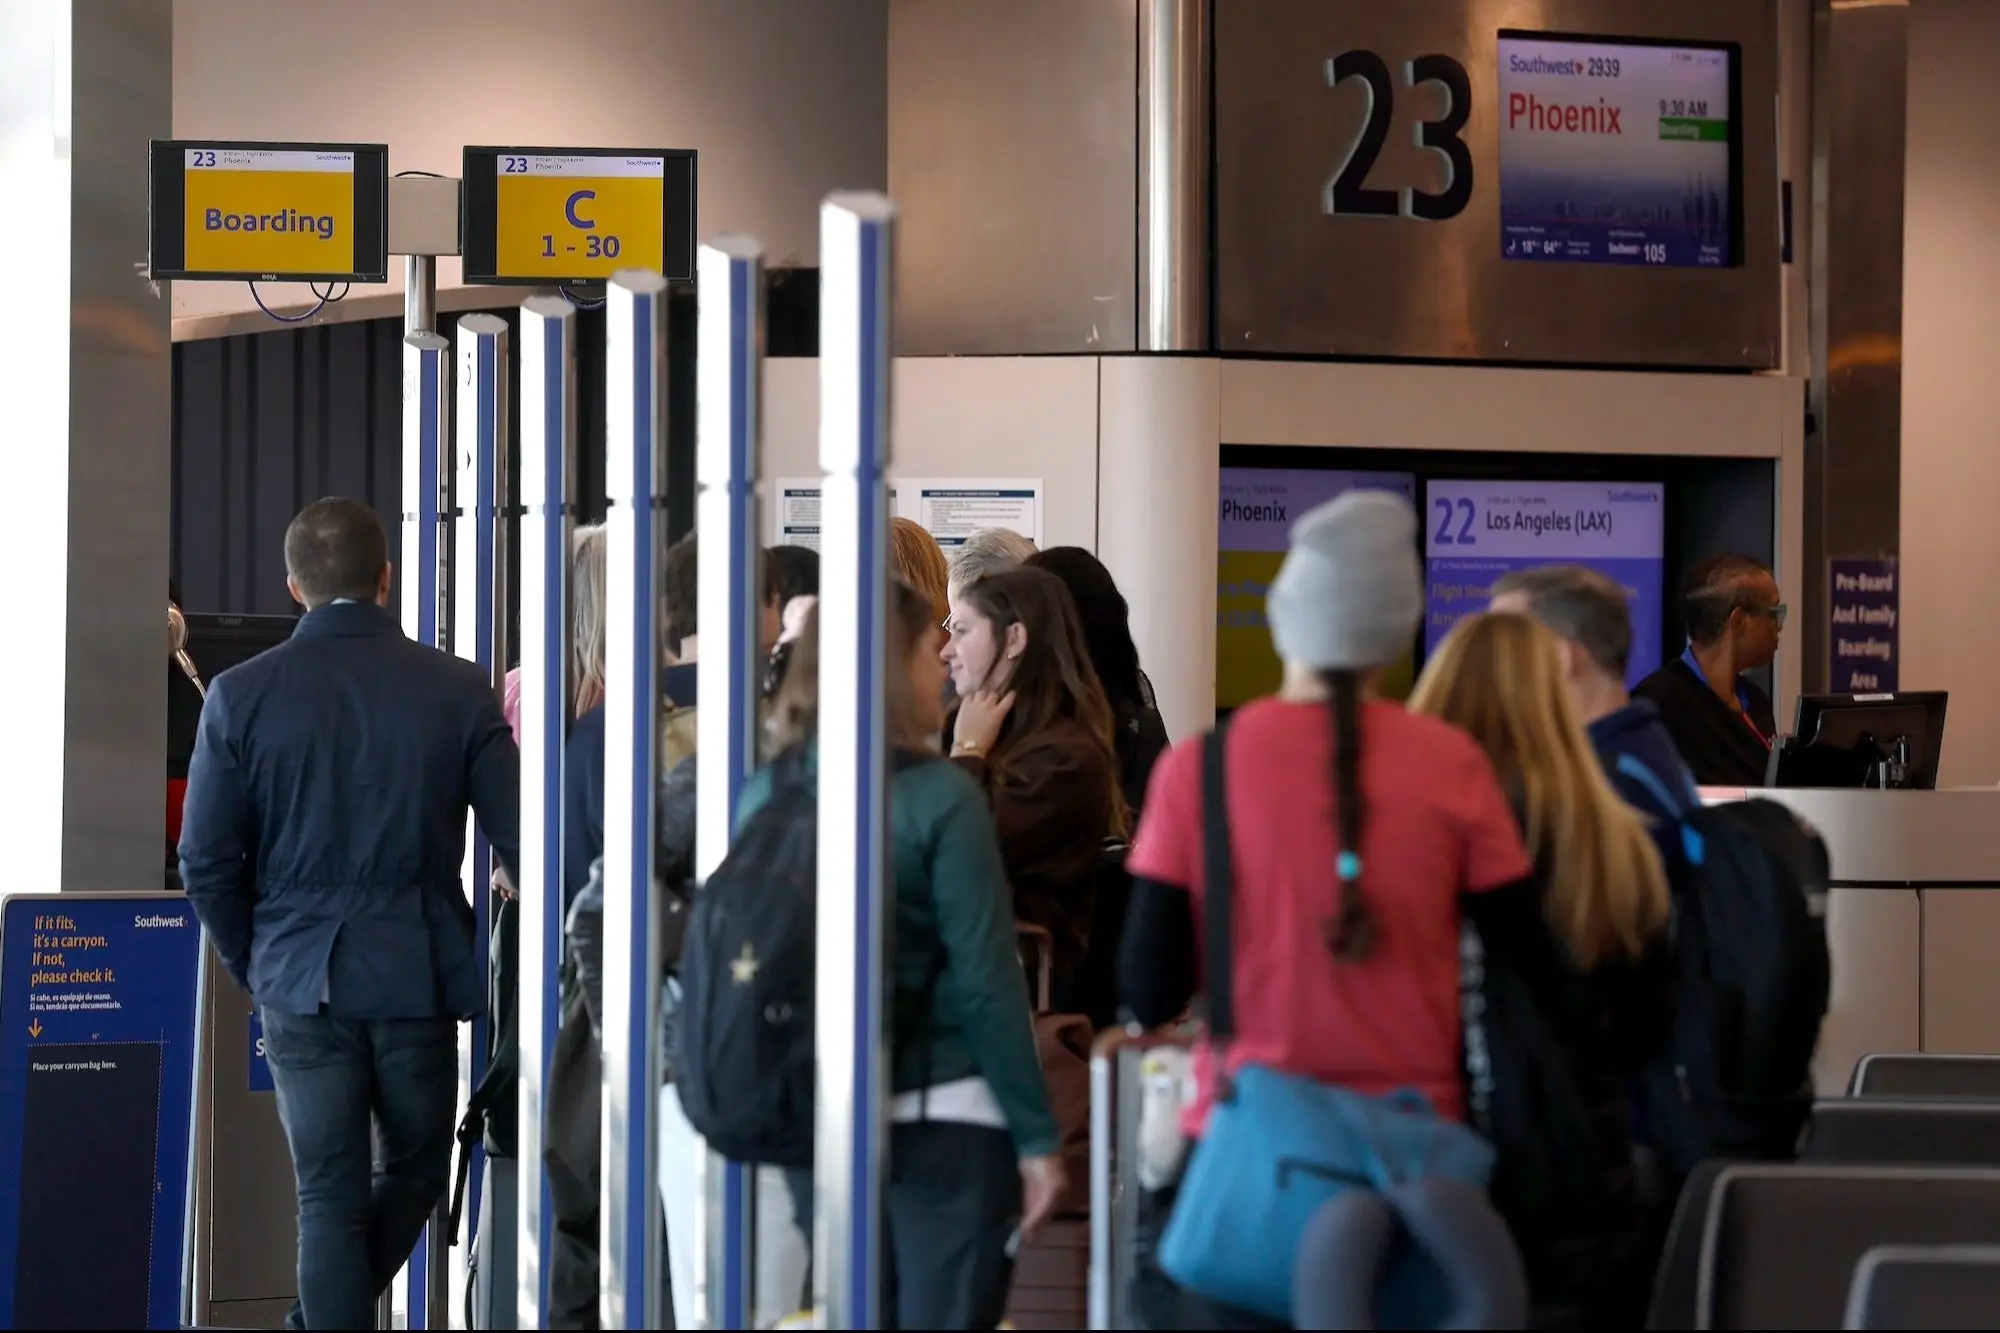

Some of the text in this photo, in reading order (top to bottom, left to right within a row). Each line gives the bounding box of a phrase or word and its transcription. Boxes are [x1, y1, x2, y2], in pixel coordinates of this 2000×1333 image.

[1509, 54, 1620, 78] Southwest 2939
[1509, 92, 1622, 134] Phoenix
[1687, 100, 1707, 117] AM
[1322, 49, 1474, 220] 23
[193, 151, 216, 167] 23
[505, 157, 528, 173] 23
[565, 190, 596, 229] C
[205, 208, 334, 240] Boarding
[542, 235, 556, 257] 1
[586, 235, 620, 258] 30
[1643, 243, 1666, 263] 105
[1222, 499, 1287, 523] Phoenix
[1434, 497, 1476, 545] 22
[1486, 509, 1612, 537] Los Angeles (LAX)
[1836, 571, 1893, 592] Pre-Board
[1832, 603, 1896, 629] And Family
[1838, 637, 1890, 661] Boarding
[1850, 670, 1878, 690] Area
[34, 914, 77, 931] If it fits,
[134, 914, 184, 928] Southwest
[33, 934, 108, 951] it's a carryon.
[32, 951, 65, 968] If not,
[31, 967, 115, 988] please check it.
[59, 992, 84, 1002] equipaje
[85, 992, 92, 1000] de
[68, 1003, 80, 1011] que
[32, 1060, 117, 1072] Place your carryon bag here.
